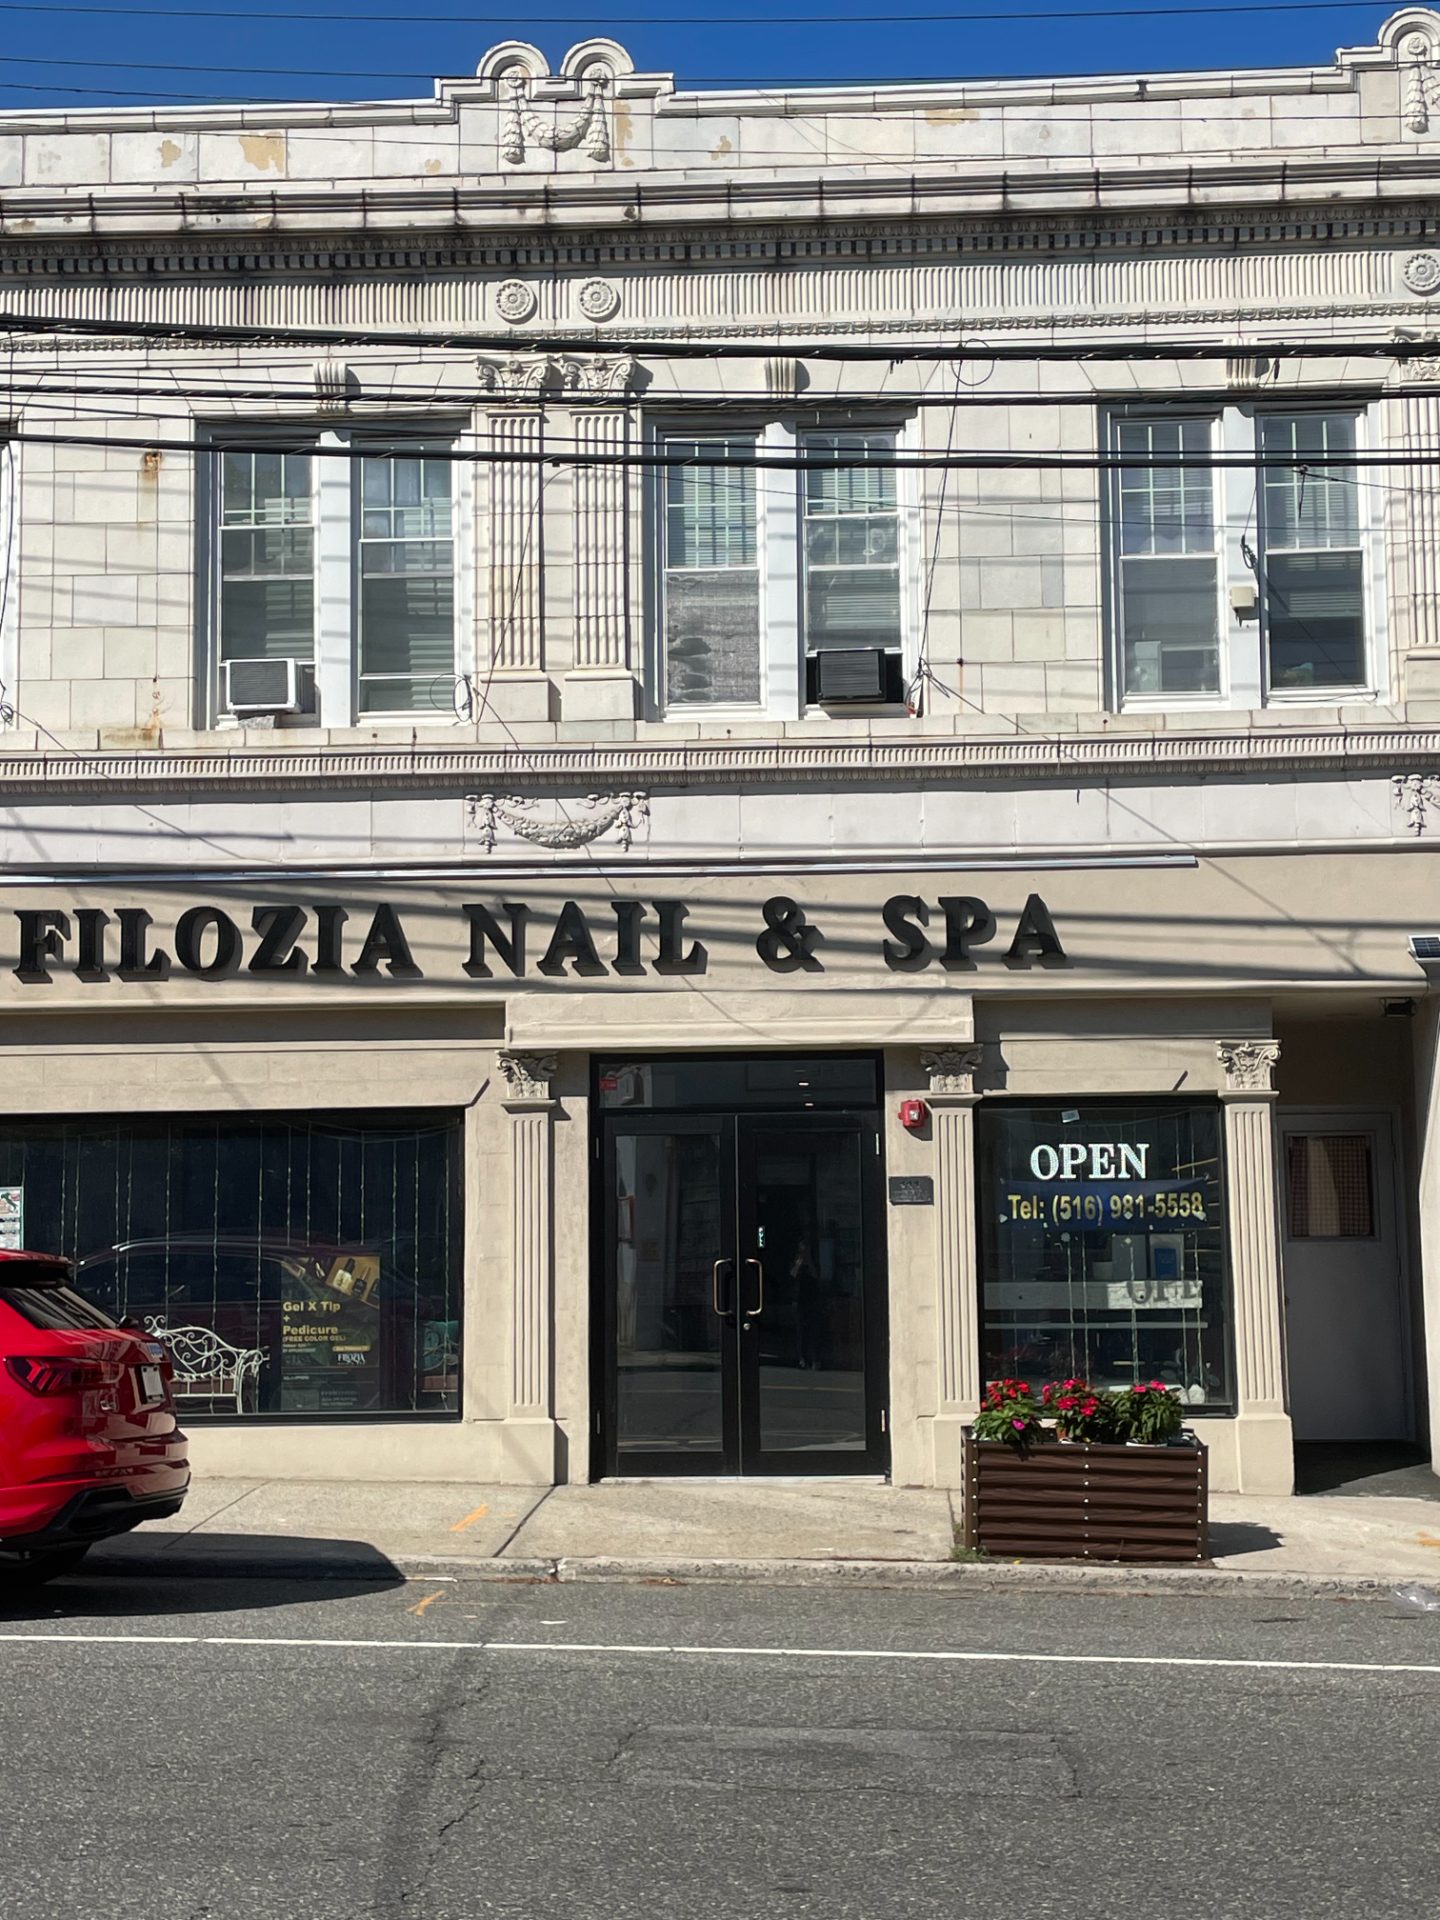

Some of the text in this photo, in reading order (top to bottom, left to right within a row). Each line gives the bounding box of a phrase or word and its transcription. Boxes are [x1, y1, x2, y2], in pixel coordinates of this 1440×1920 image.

[13, 893, 1074, 983] FILOZIA NAIL & SPA
[1030, 1143, 1149, 1180] OPEN
[1008, 1192, 1204, 1226] Tel: (516) 981-5558
[282, 1301, 341, 1313] Gel X Tip
[283, 1314, 290, 1322] +
[282, 1325, 338, 1335] Pedicure
